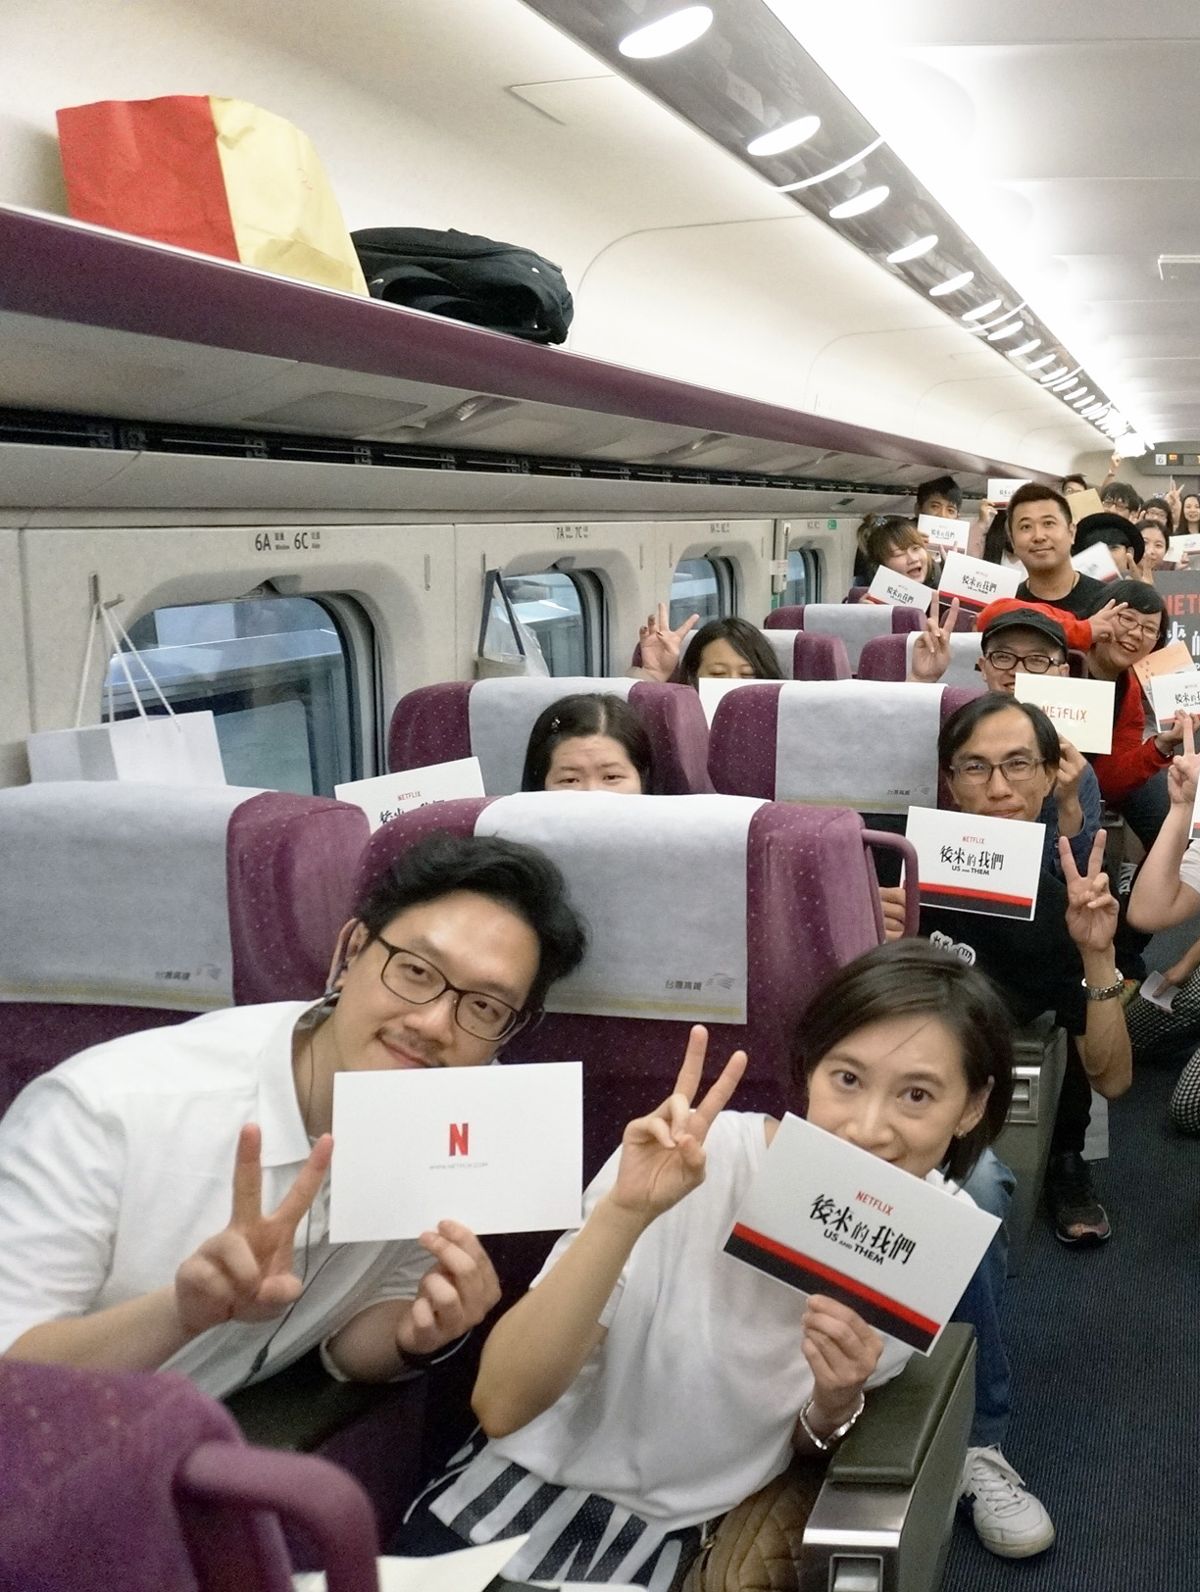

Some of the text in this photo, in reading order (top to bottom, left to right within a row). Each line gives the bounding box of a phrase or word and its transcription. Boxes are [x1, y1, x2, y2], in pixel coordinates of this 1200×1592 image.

[255, 533, 272, 551] 6A
[294, 532, 308, 549] 6C
[1042, 705, 1088, 722] NETFLIX
[940, 845, 1004, 871] 後來的我們
[449, 1123, 469, 1157] N
[856, 1190, 894, 1216] NETFLIX
[810, 1194, 916, 1265] 後來的我們
[823, 1228, 838, 1243] US
[854, 1243, 884, 1265] THEM
